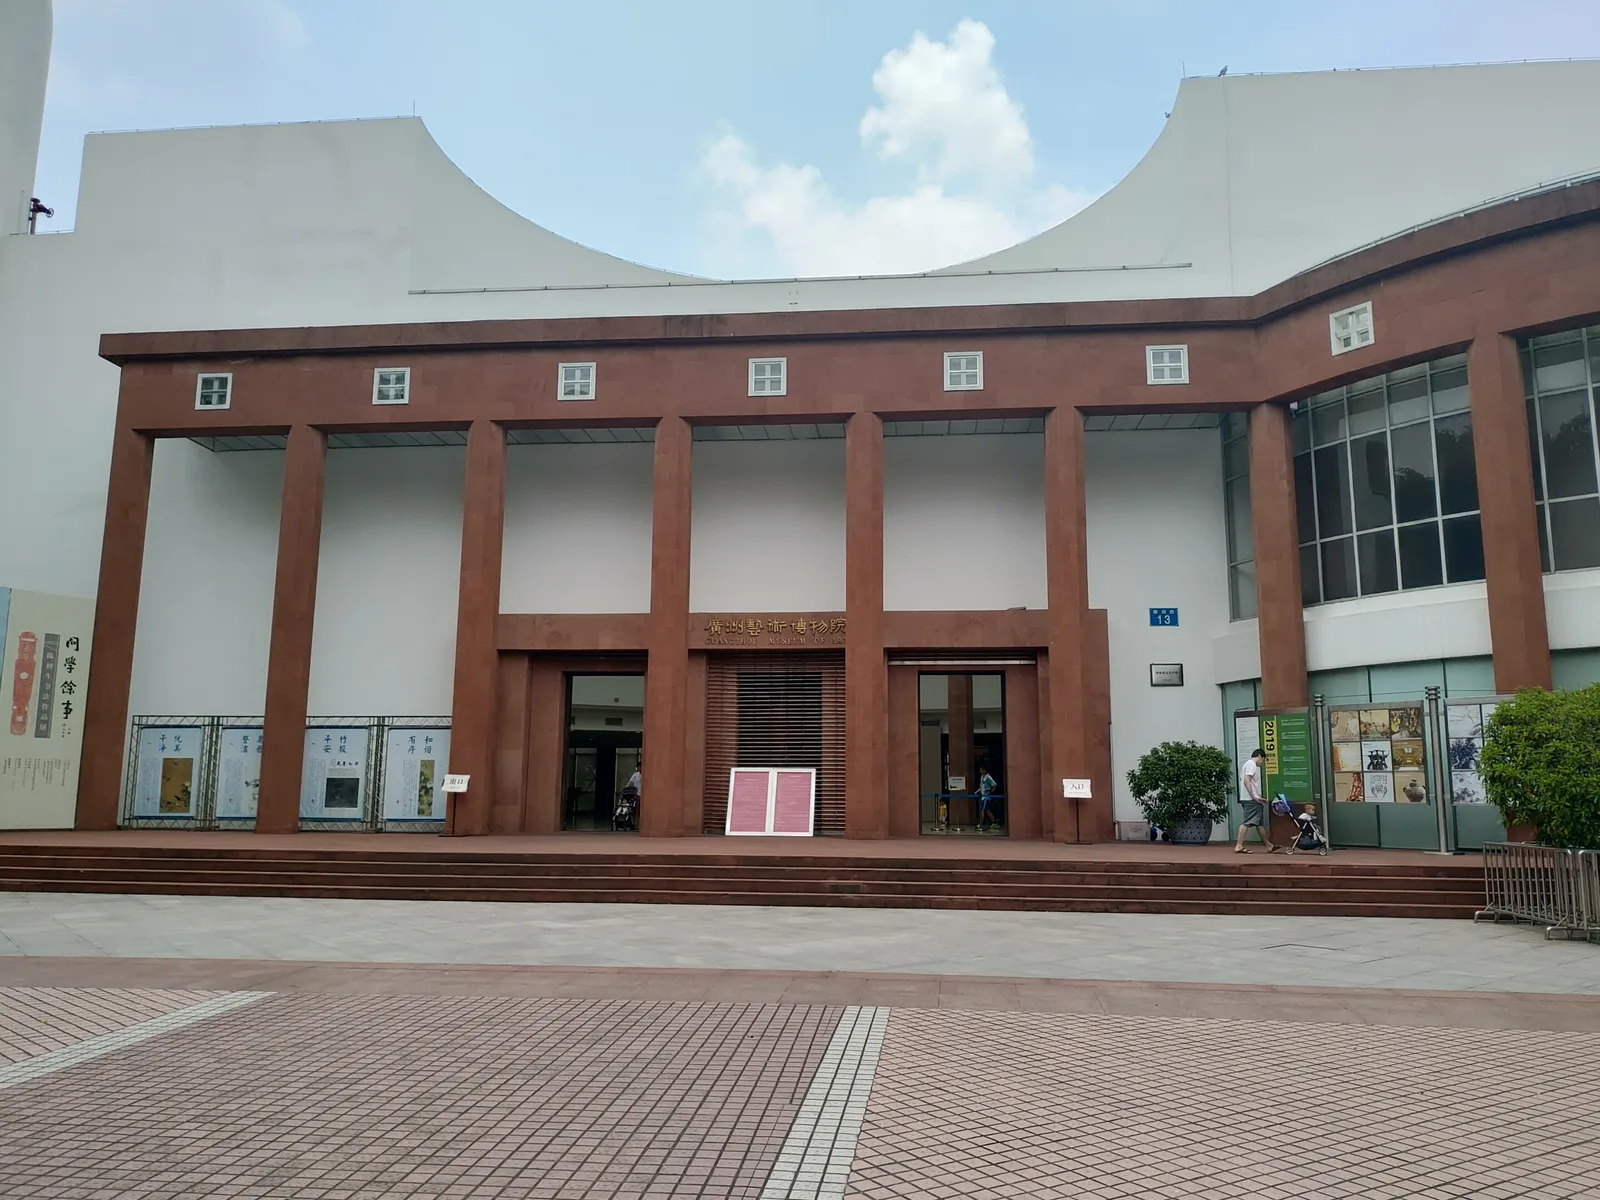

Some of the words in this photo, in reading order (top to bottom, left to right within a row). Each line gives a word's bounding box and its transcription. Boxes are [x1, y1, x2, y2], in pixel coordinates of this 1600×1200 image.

[1157, 614, 1171, 625] 13
[768, 637, 807, 646] MUSEUM
[813, 637, 825, 645] OF
[1265, 721, 1275, 751] 2019
[1070, 782, 1085, 790] 入口
